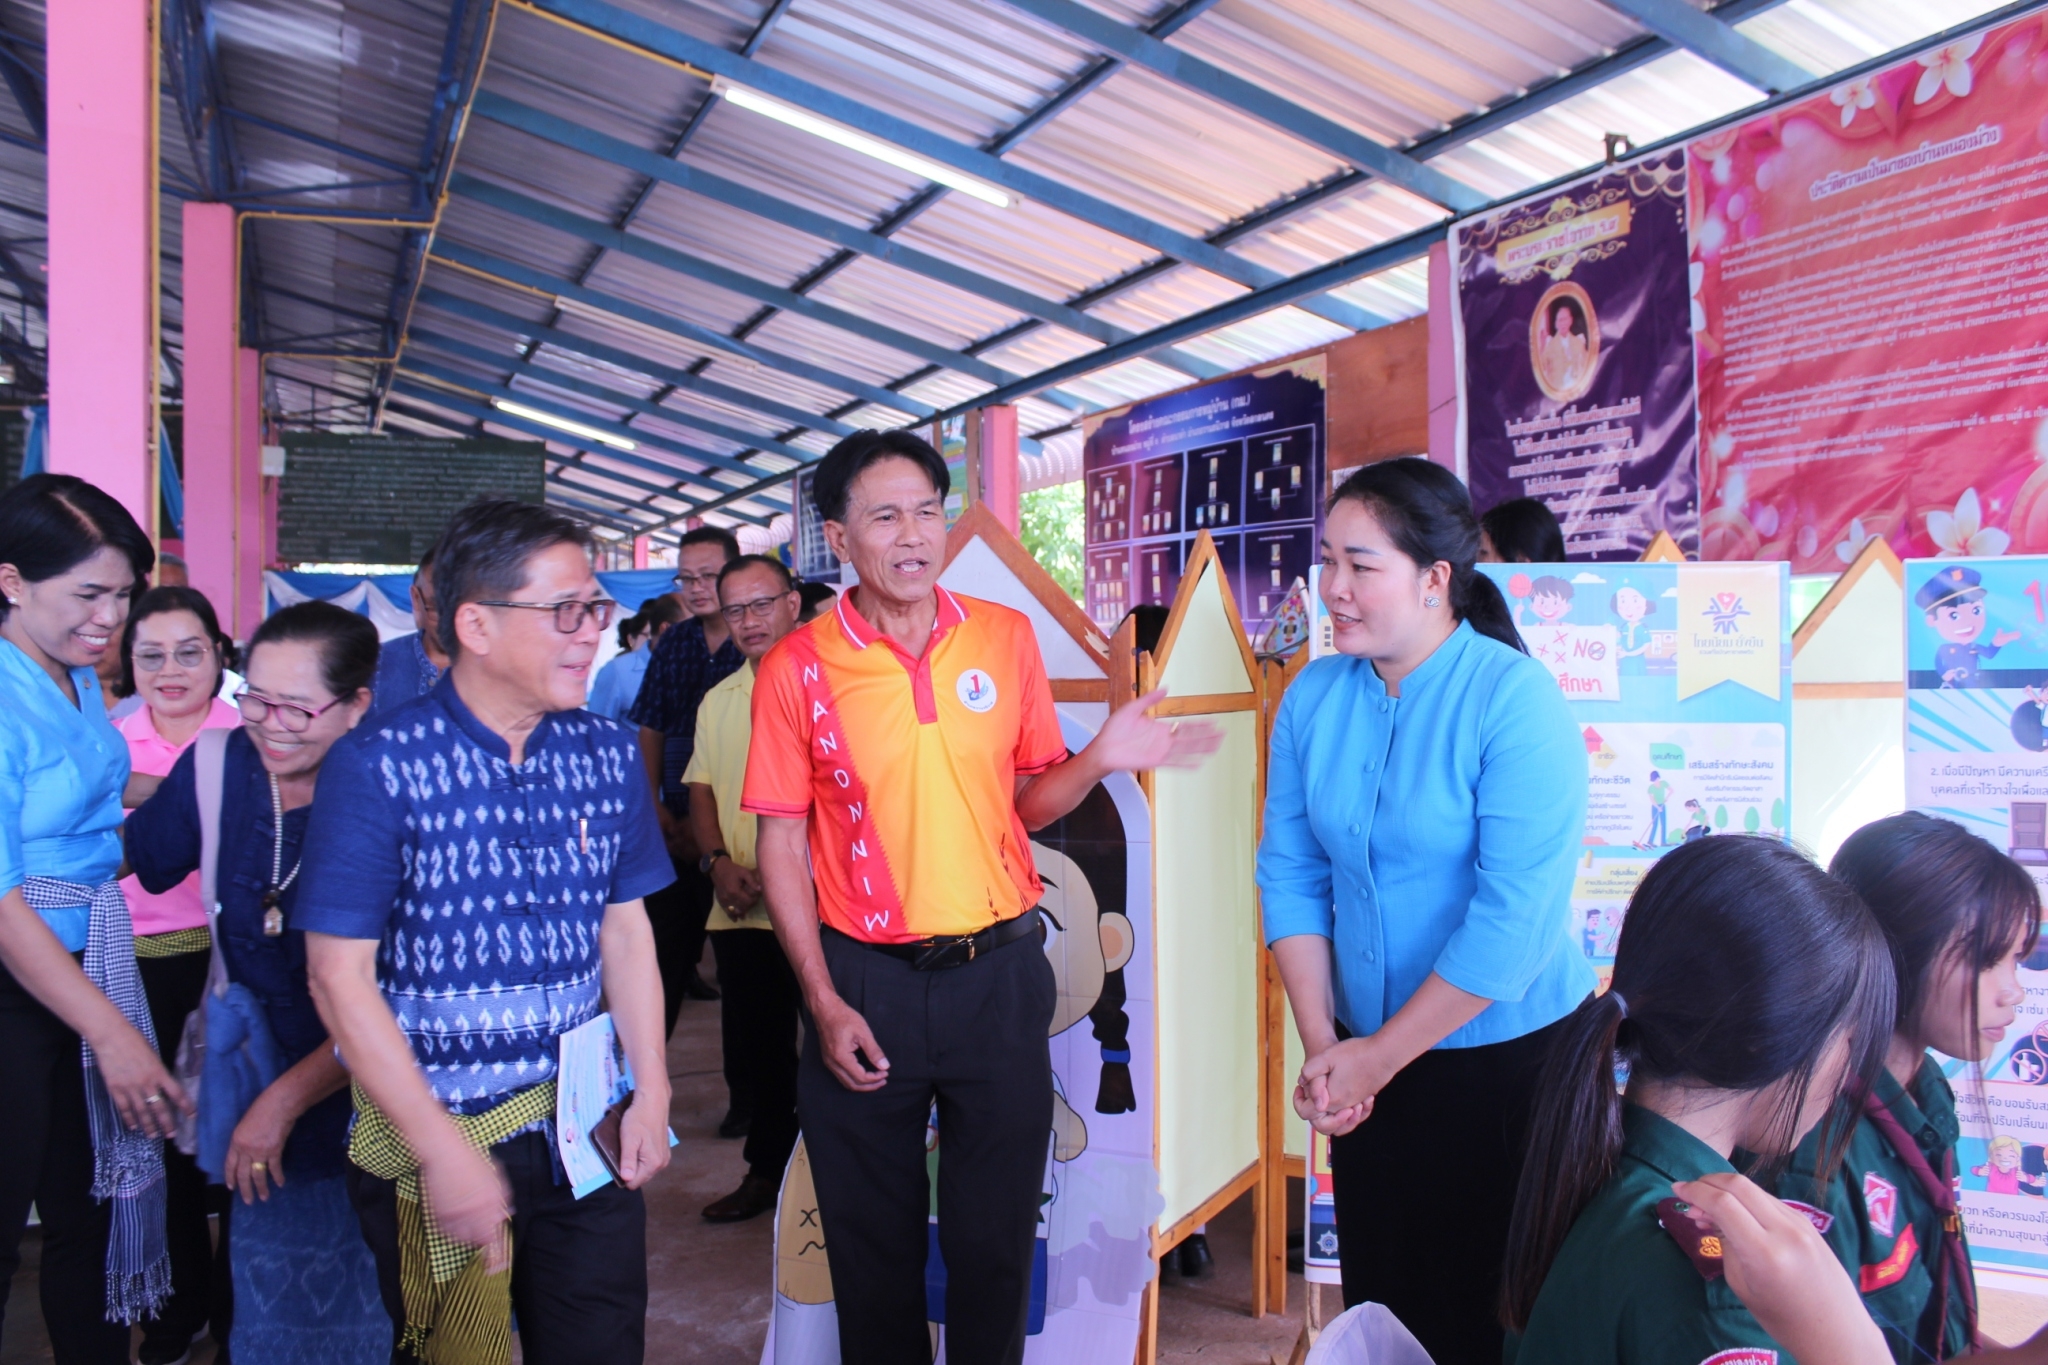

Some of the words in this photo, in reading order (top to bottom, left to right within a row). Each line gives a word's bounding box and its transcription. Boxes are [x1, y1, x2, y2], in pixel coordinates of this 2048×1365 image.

[1810, 125, 1999, 199] ประวัติความเป็นมาของบ้านหนองม่วง
[2023, 580, 2048, 623] 1
[1688, 758, 1774, 769] เสริมสร้างทักษะสังคม
[1930, 767, 1939, 776] 2.
[1942, 762, 1996, 777] เมื่อมีปัญหา
[2005, 1098, 2048, 1111] ยอมรับส
